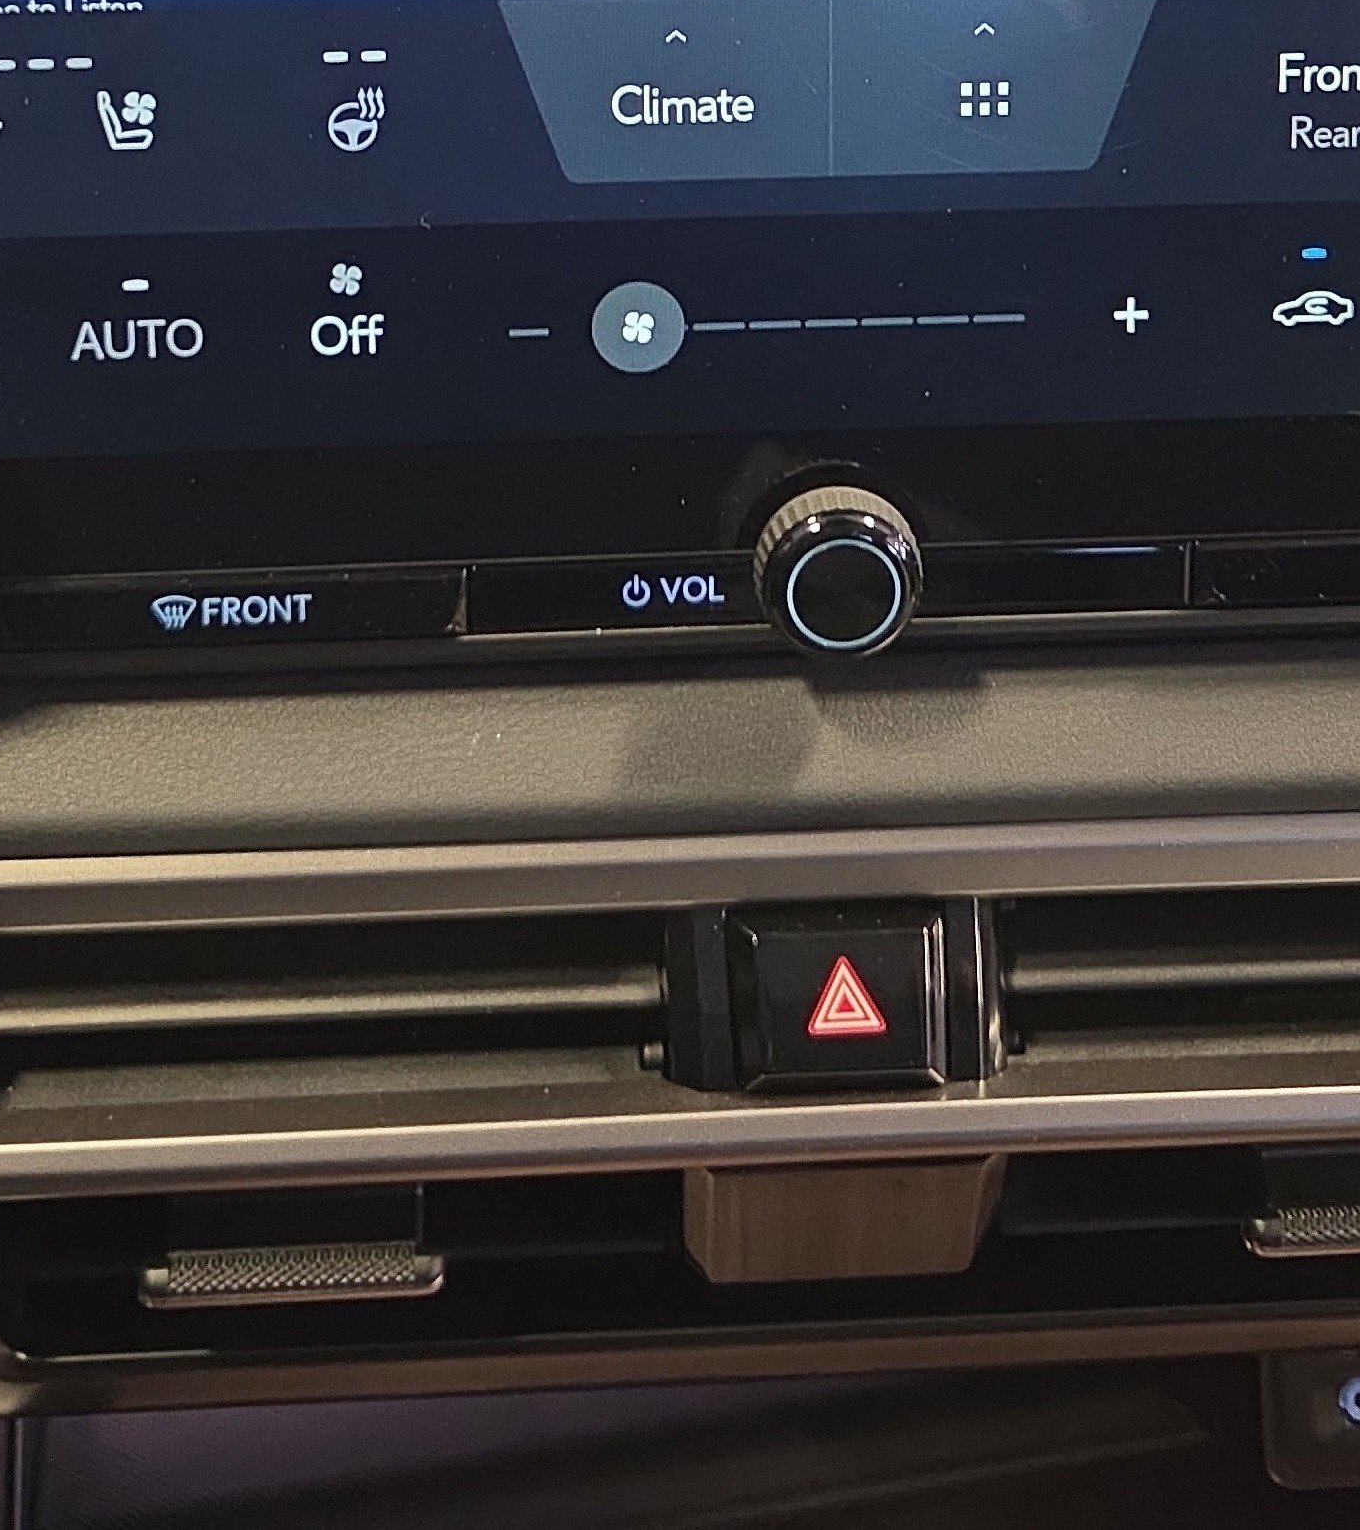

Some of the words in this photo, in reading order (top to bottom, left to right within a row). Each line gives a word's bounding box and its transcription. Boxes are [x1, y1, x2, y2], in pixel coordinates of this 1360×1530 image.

[611, 84, 754, 129] Climate
[70, 318, 204, 362] AUTO
[310, 315, 384, 358] Off
[201, 594, 312, 626] FRONT
[659, 576, 724, 605] VOL
